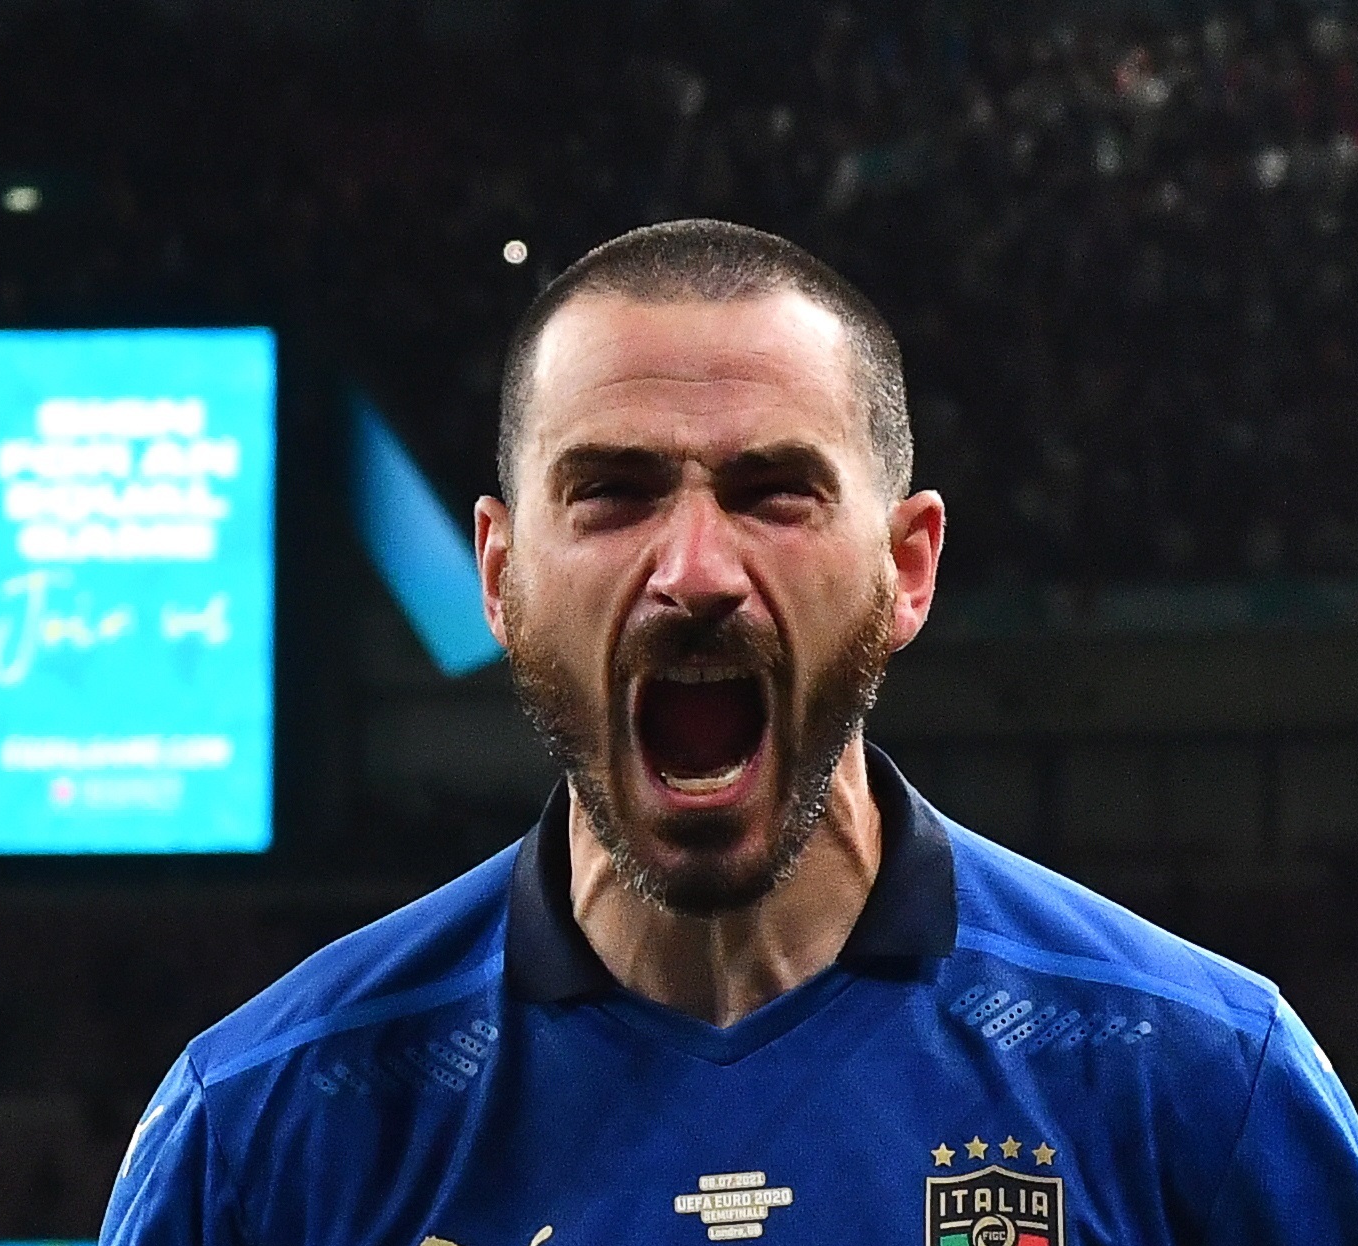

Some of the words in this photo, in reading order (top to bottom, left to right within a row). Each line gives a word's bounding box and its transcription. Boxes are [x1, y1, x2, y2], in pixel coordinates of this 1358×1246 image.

[677, 1197, 712, 1211] UEFA
[715, 1194, 751, 1207] EURO
[755, 1190, 791, 1205] 2020
[939, 1187, 1048, 1217] ITALIA
[982, 1231, 1006, 1241] FIGC
